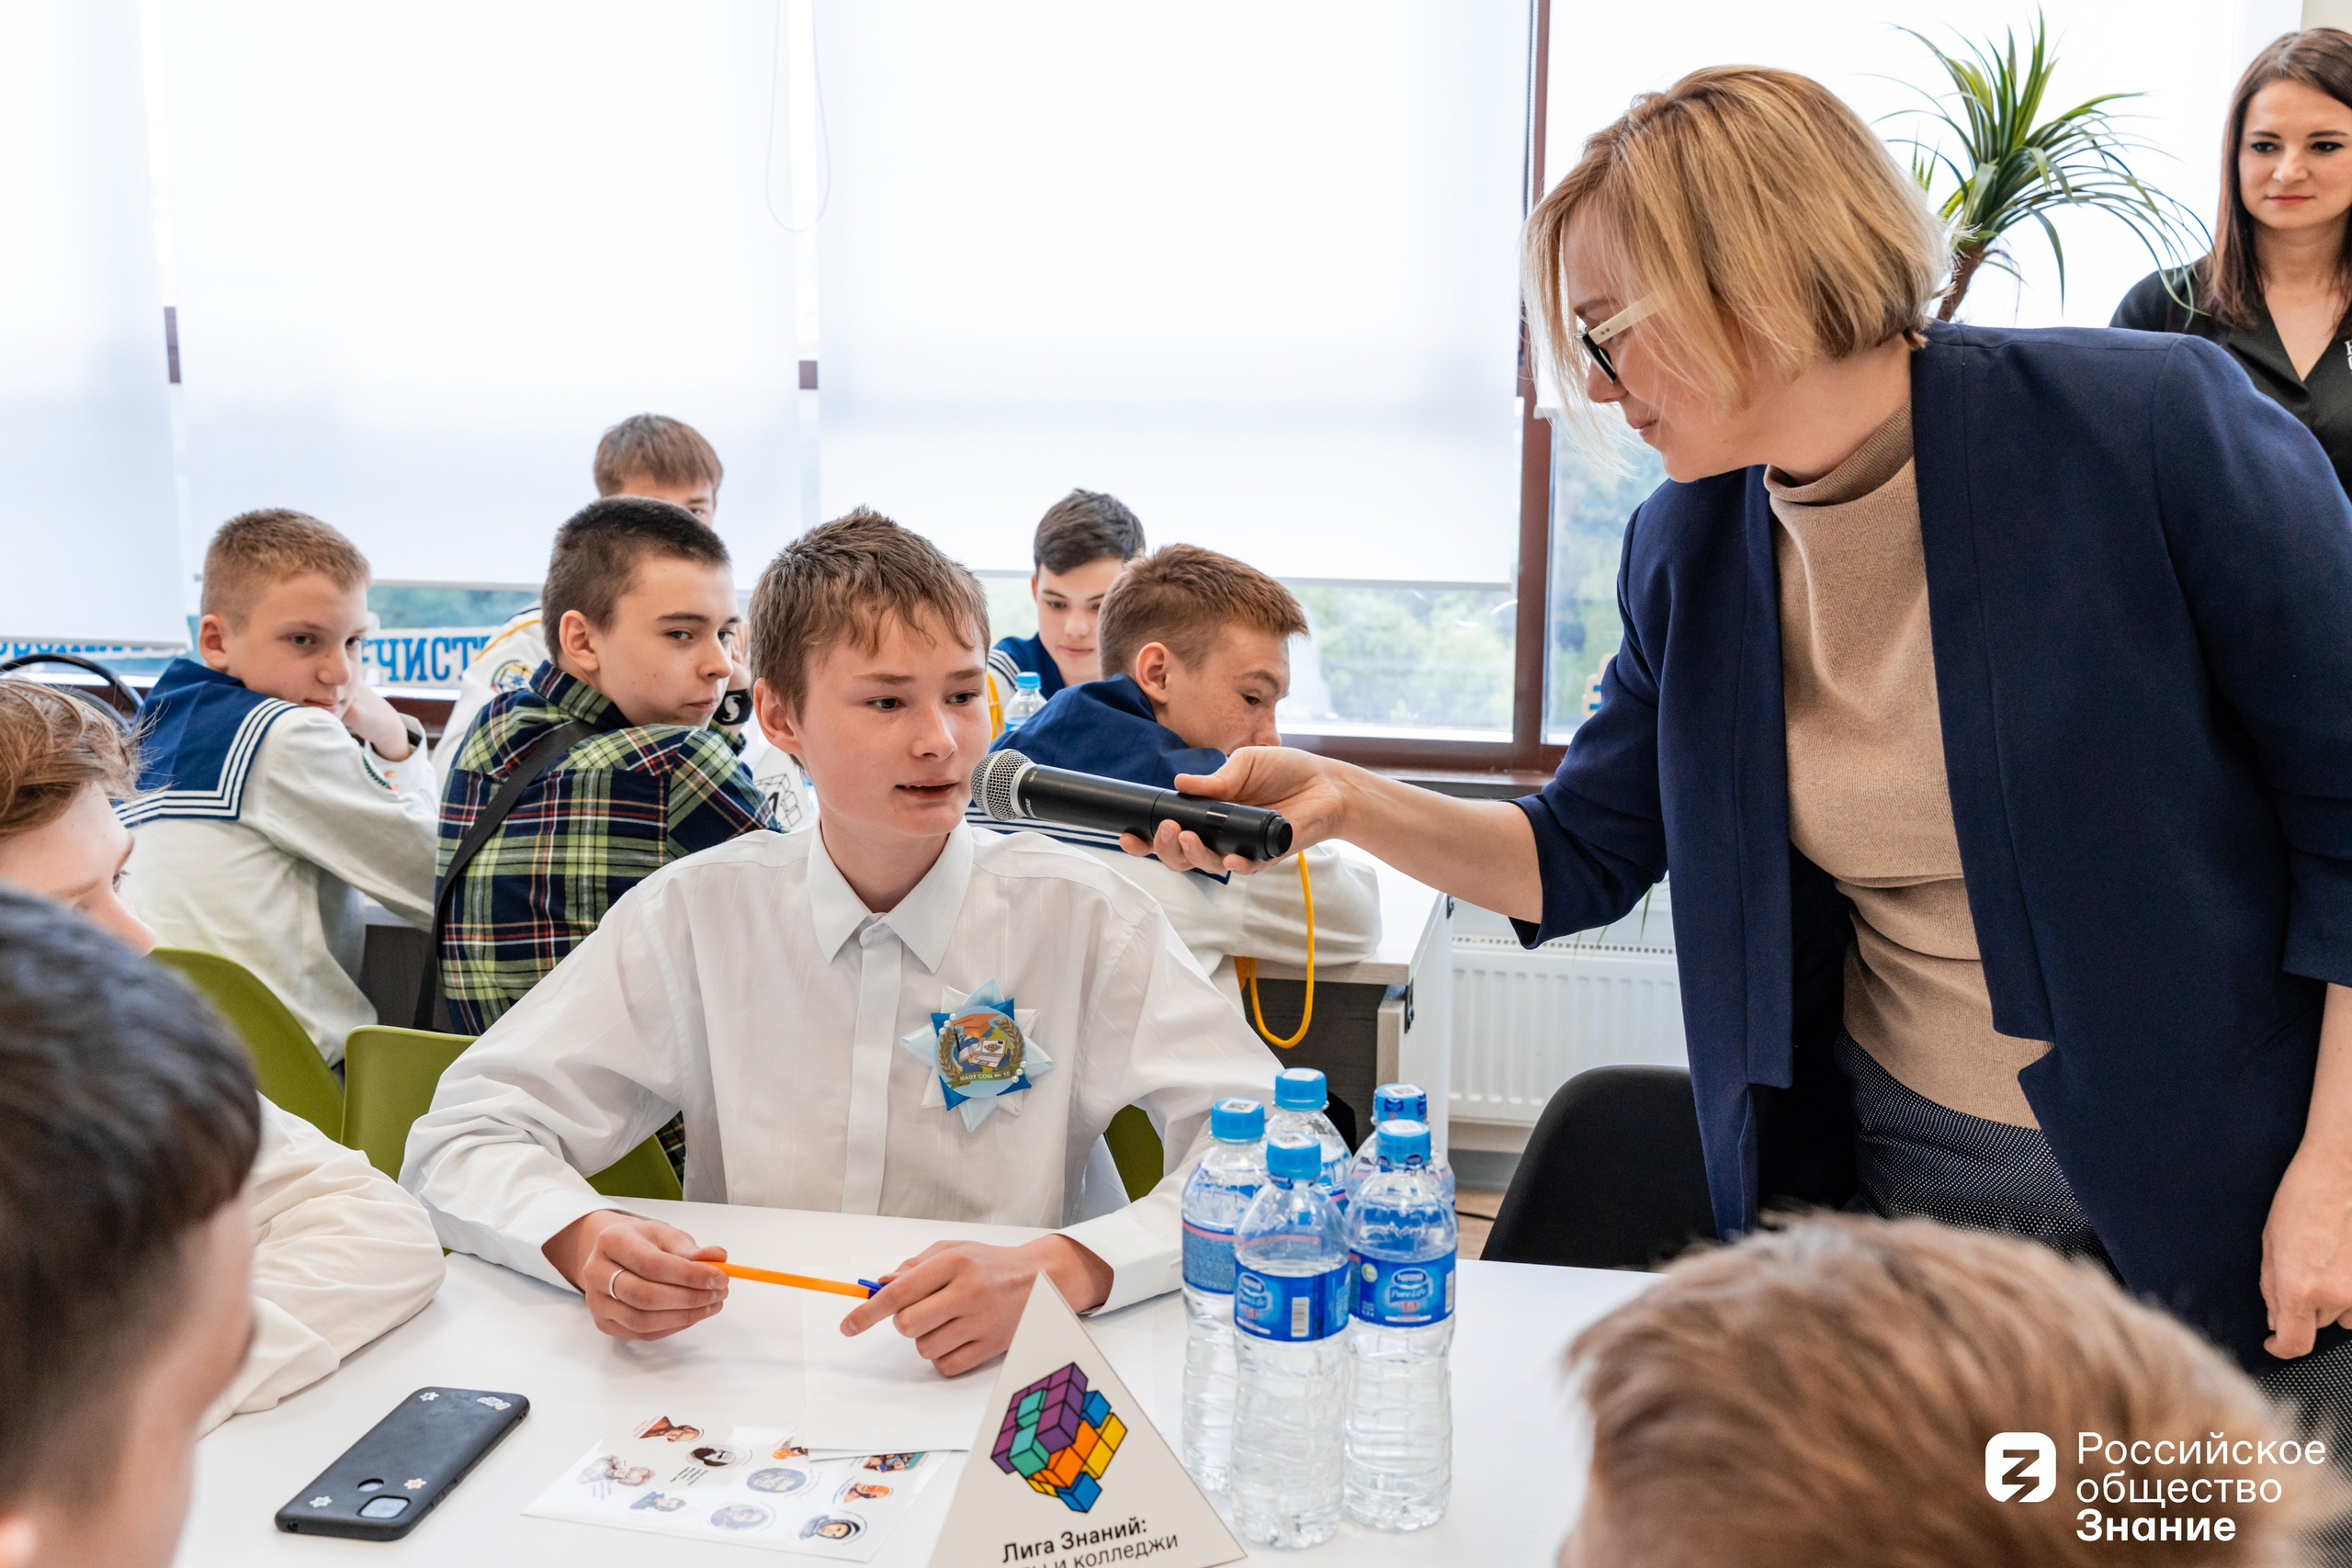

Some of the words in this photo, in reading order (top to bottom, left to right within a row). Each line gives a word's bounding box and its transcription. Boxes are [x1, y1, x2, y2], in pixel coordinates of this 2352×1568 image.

[361, 637, 492, 682] ЧИСТ
[959, 1073, 977, 1081] МАОУ
[1002, 1540, 1055, 1563] Лига
[1060, 1517, 1148, 1550] Знаний:
[1073, 1534, 1179, 1568] колледжи
